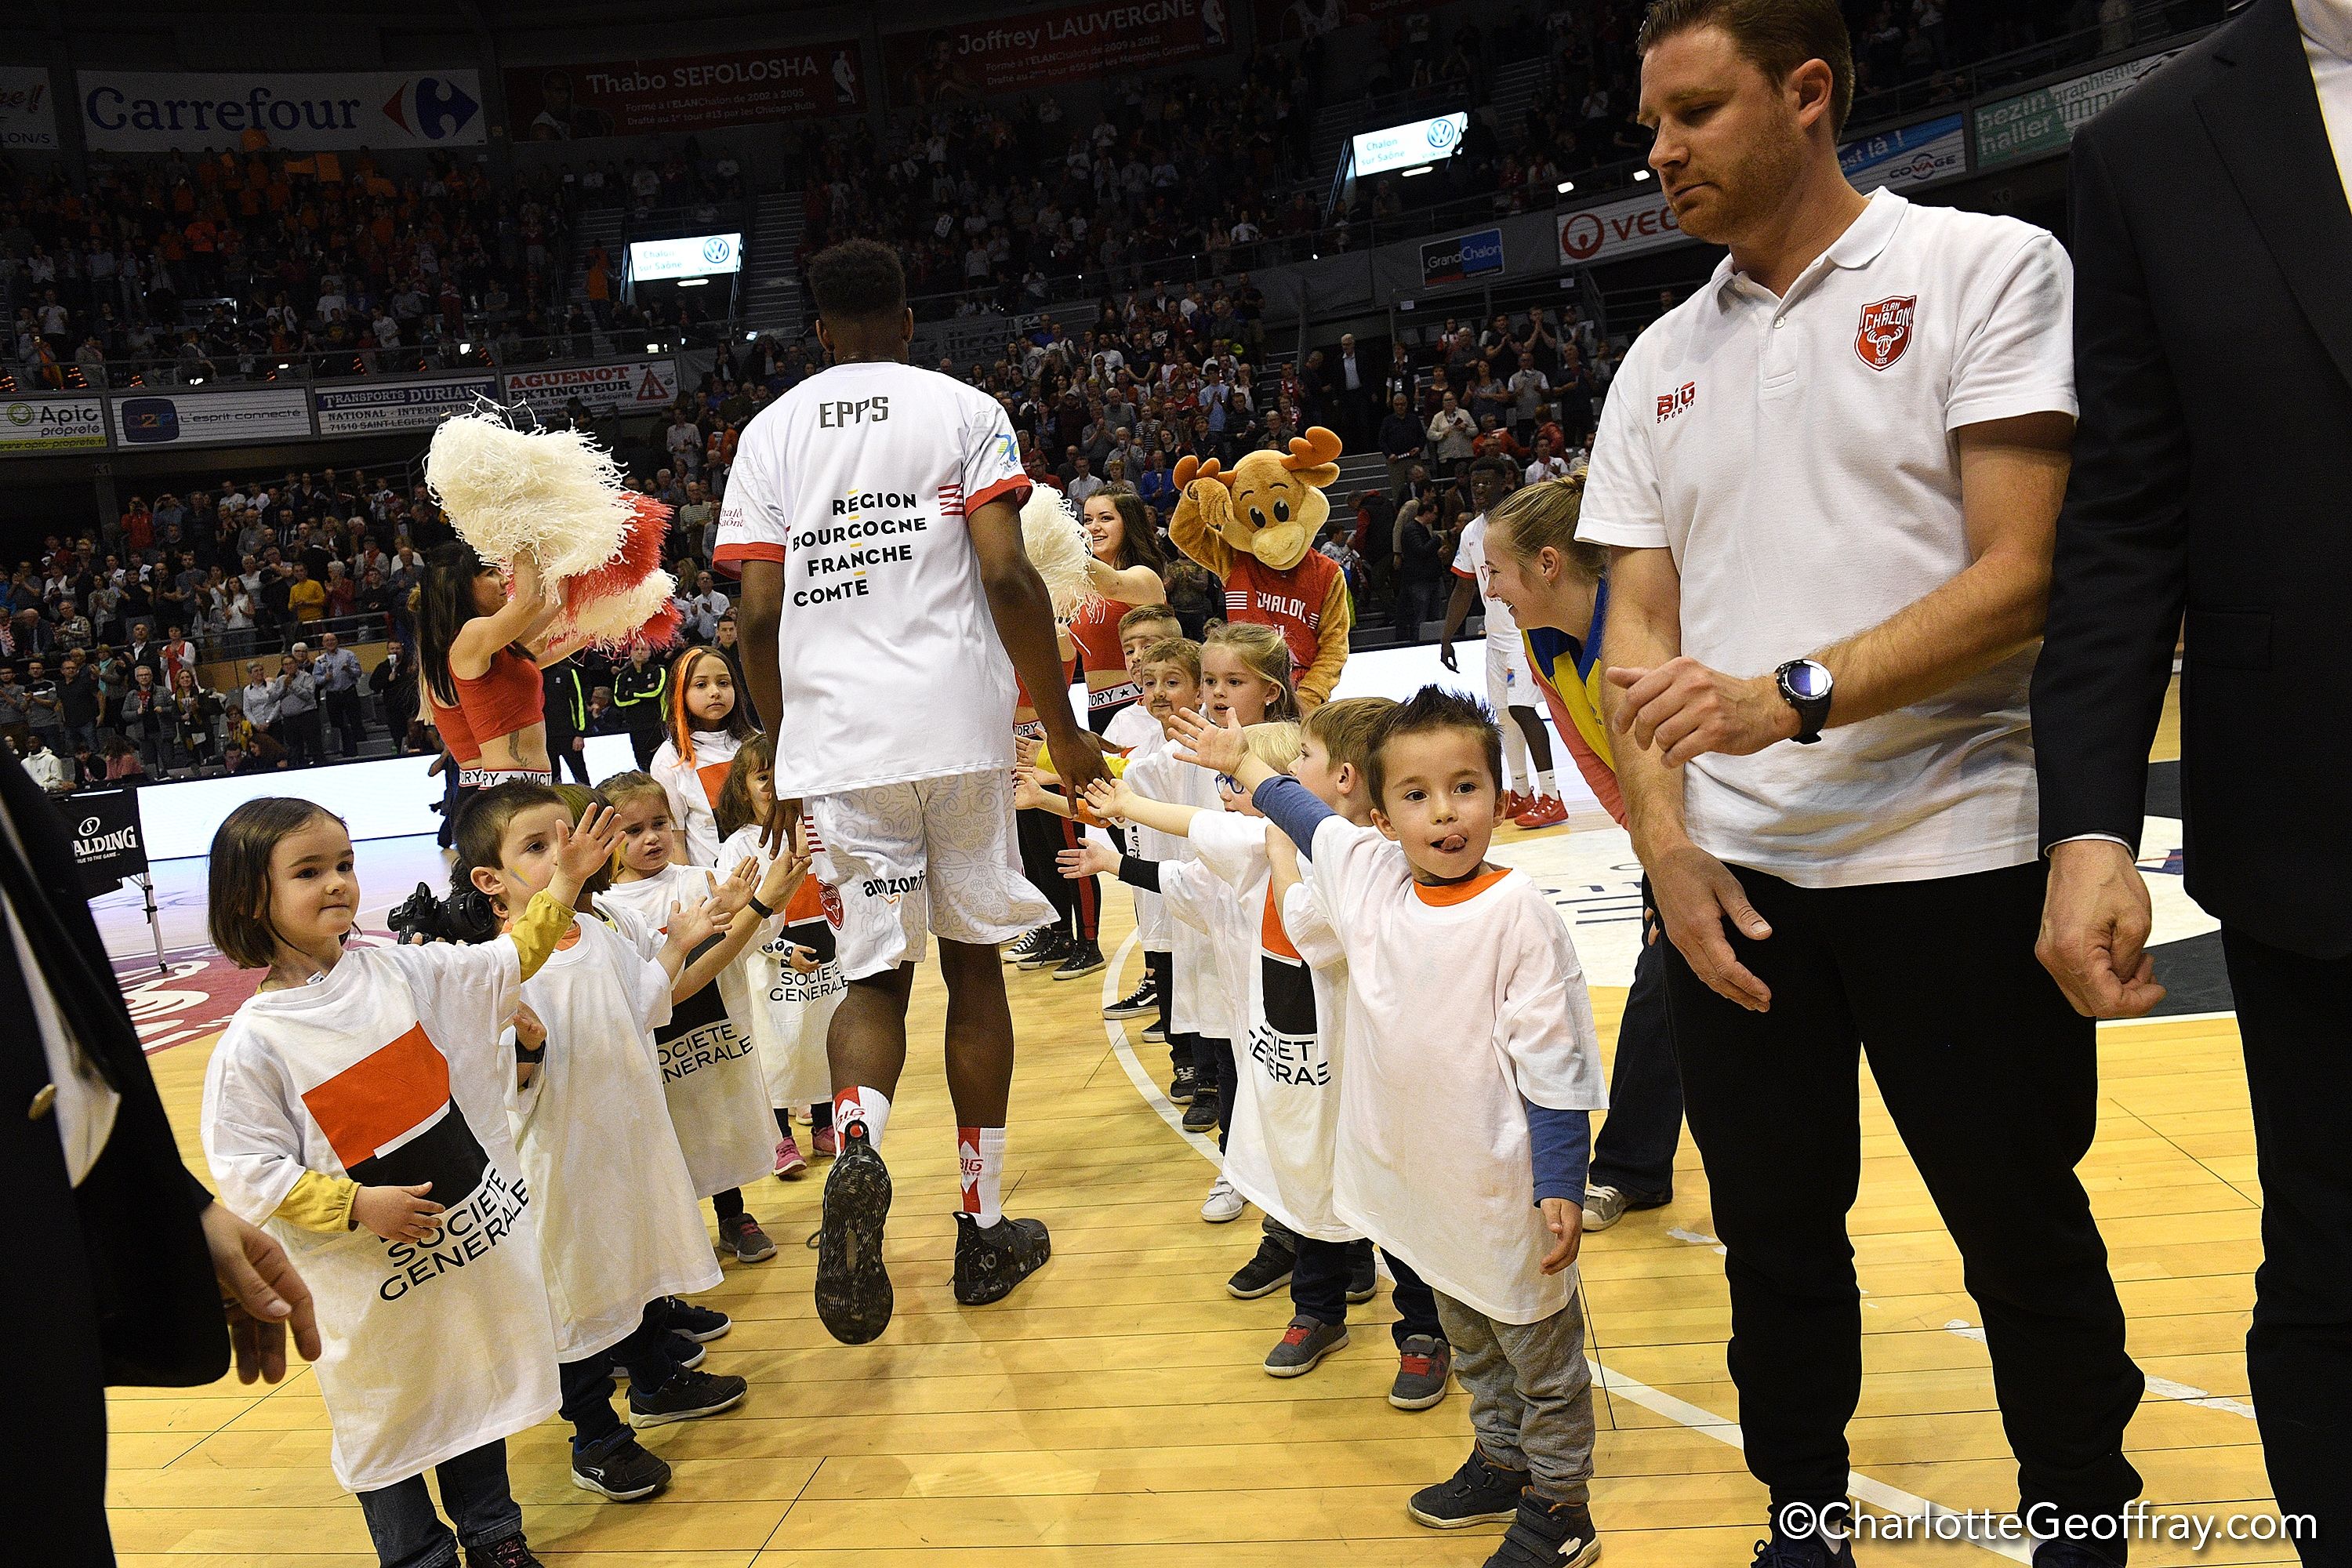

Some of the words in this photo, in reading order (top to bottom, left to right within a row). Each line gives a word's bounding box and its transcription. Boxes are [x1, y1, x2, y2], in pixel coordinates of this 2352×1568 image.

[957, 27, 1040, 55] Joffrey
[1046, 0, 1195, 41] LAUVERGNE
[985, 60, 1016, 71] Formé
[1091, 45, 1102, 55] de
[1105, 42, 1127, 53] 2009
[1138, 34, 1160, 46] 2012
[586, 71, 666, 94] Thabo
[673, 56, 818, 88] SEFOLOSHA
[987, 74, 1014, 86] Drafté
[1047, 66, 1066, 76] tour
[1088, 59, 1104, 71] par
[1105, 56, 1118, 66] les
[1120, 50, 1160, 64] Memphis
[86, 86, 361, 132] Carrefour
[626, 102, 657, 113] Formé
[732, 95, 746, 103] de
[747, 92, 770, 101] 2002
[781, 88, 804, 98] 2005
[627, 115, 655, 125] Drafté
[683, 112, 702, 121] tour
[706, 110, 722, 119] #13
[724, 111, 739, 120] par
[741, 107, 754, 116] les
[755, 103, 792, 117] Chicago
[794, 100, 816, 111] Bulls
[1977, 93, 2047, 132] bezin
[1367, 139, 1398, 151] Chalon
[1867, 136, 1889, 158] là
[1980, 114, 2052, 155] haller
[1377, 150, 1405, 162] Saône
[1889, 154, 1957, 179] COVAGE
[644, 250, 675, 259] Chalon
[655, 261, 682, 270] Saône
[1864, 307, 1911, 332] CHALON
[1882, 302, 1900, 312] ELAN
[509, 366, 630, 389] AGUENOT
[323, 390, 405, 408] TRANSPORTS
[510, 381, 632, 400] EXTINCTEUR
[40, 405, 98, 426] Apic
[180, 413, 230, 424] L'esprit
[235, 409, 300, 419] connecté
[328, 410, 387, 422] NATIONAL
[819, 396, 888, 429] EPPS
[1657, 400, 1695, 424] SPORTS
[793, 517, 927, 552] BOURGOGNE
[807, 544, 913, 577] FRANCHE
[769, 975, 848, 1001] GENERALE
[661, 1036, 753, 1084] NERALE
[836, 1108, 866, 1127] BIG
[387, 1167, 507, 1268] SOCIETE
[379, 1178, 529, 1301] GENERALE
